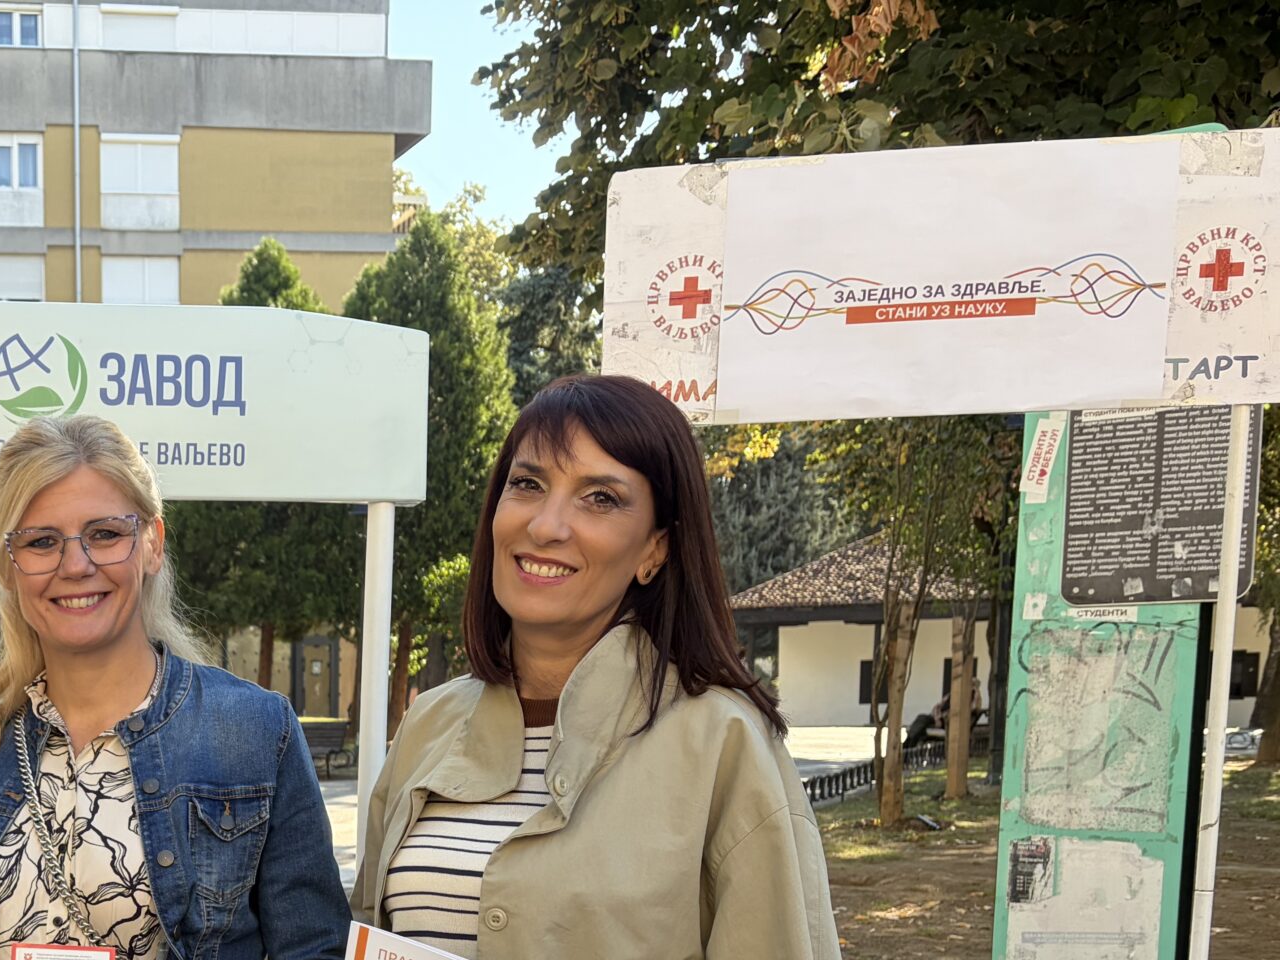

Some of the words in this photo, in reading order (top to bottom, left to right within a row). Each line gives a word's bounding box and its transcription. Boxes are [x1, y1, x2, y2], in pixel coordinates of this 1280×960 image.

[1176, 226, 1238, 278] ЦРВЕНИ
[1239, 232, 1267, 276] КРСТ
[647, 254, 705, 306] ЦРВЕНИ
[833, 286, 918, 304] ЗАЈЕДНО
[922, 284, 946, 298] ЗА
[950, 279, 1047, 300] ЗДРАВЉЕ.
[875, 305, 928, 320] СТАНИ
[931, 303, 951, 318] УЗ
[954, 302, 1007, 316] НАУКУ.
[1182, 286, 1254, 313] ВАЉЕВО
[653, 314, 721, 340] ВАЉЕВО
[99, 352, 247, 416] ЗАВОД
[157, 442, 246, 466] ВАЉЕВО
[1027, 430, 1049, 481] СТУДЕНТИ
[1076, 608, 1128, 618] СТУДЕНТИ
